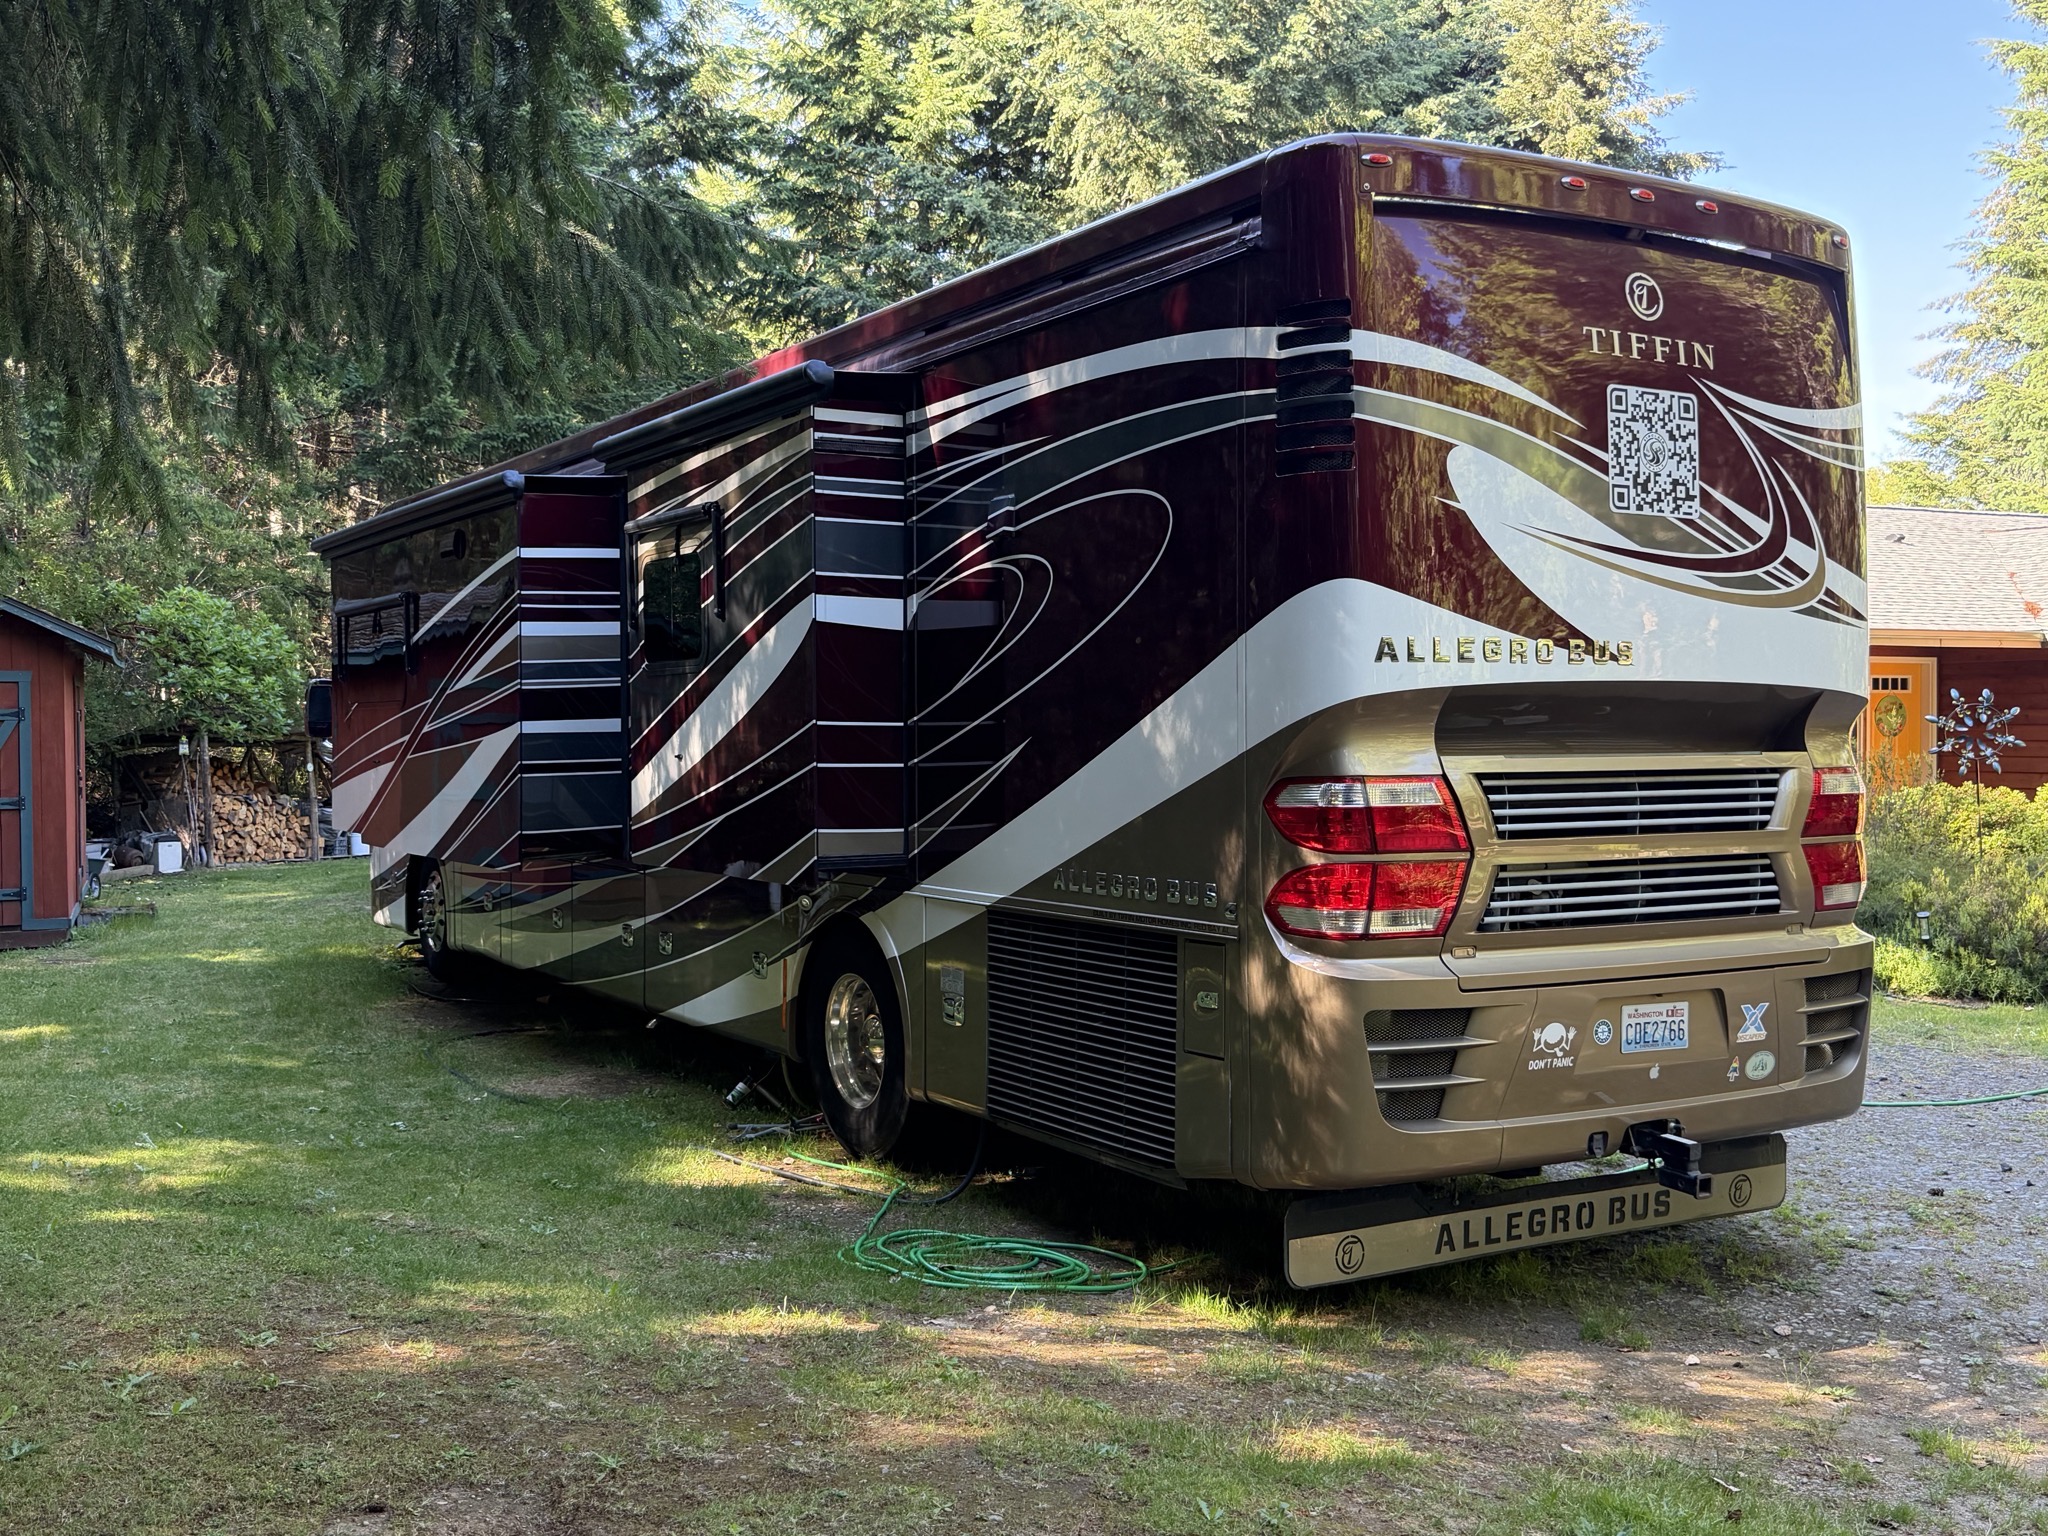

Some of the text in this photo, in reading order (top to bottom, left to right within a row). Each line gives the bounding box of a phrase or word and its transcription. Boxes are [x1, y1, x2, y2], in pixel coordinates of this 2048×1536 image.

[1582, 326, 1715, 371] TIFFIN
[1374, 635, 1635, 667] ALLEGRO BUS
[1053, 868, 1218, 908] ALLEGRO BUS
[1627, 1010, 1664, 1019] WASHINGTON
[1625, 1019, 1685, 1046] CDE2766
[1528, 1056, 1575, 1071] DON'T PANIC
[1434, 1189, 1671, 1255] ALLEGRO BUS
